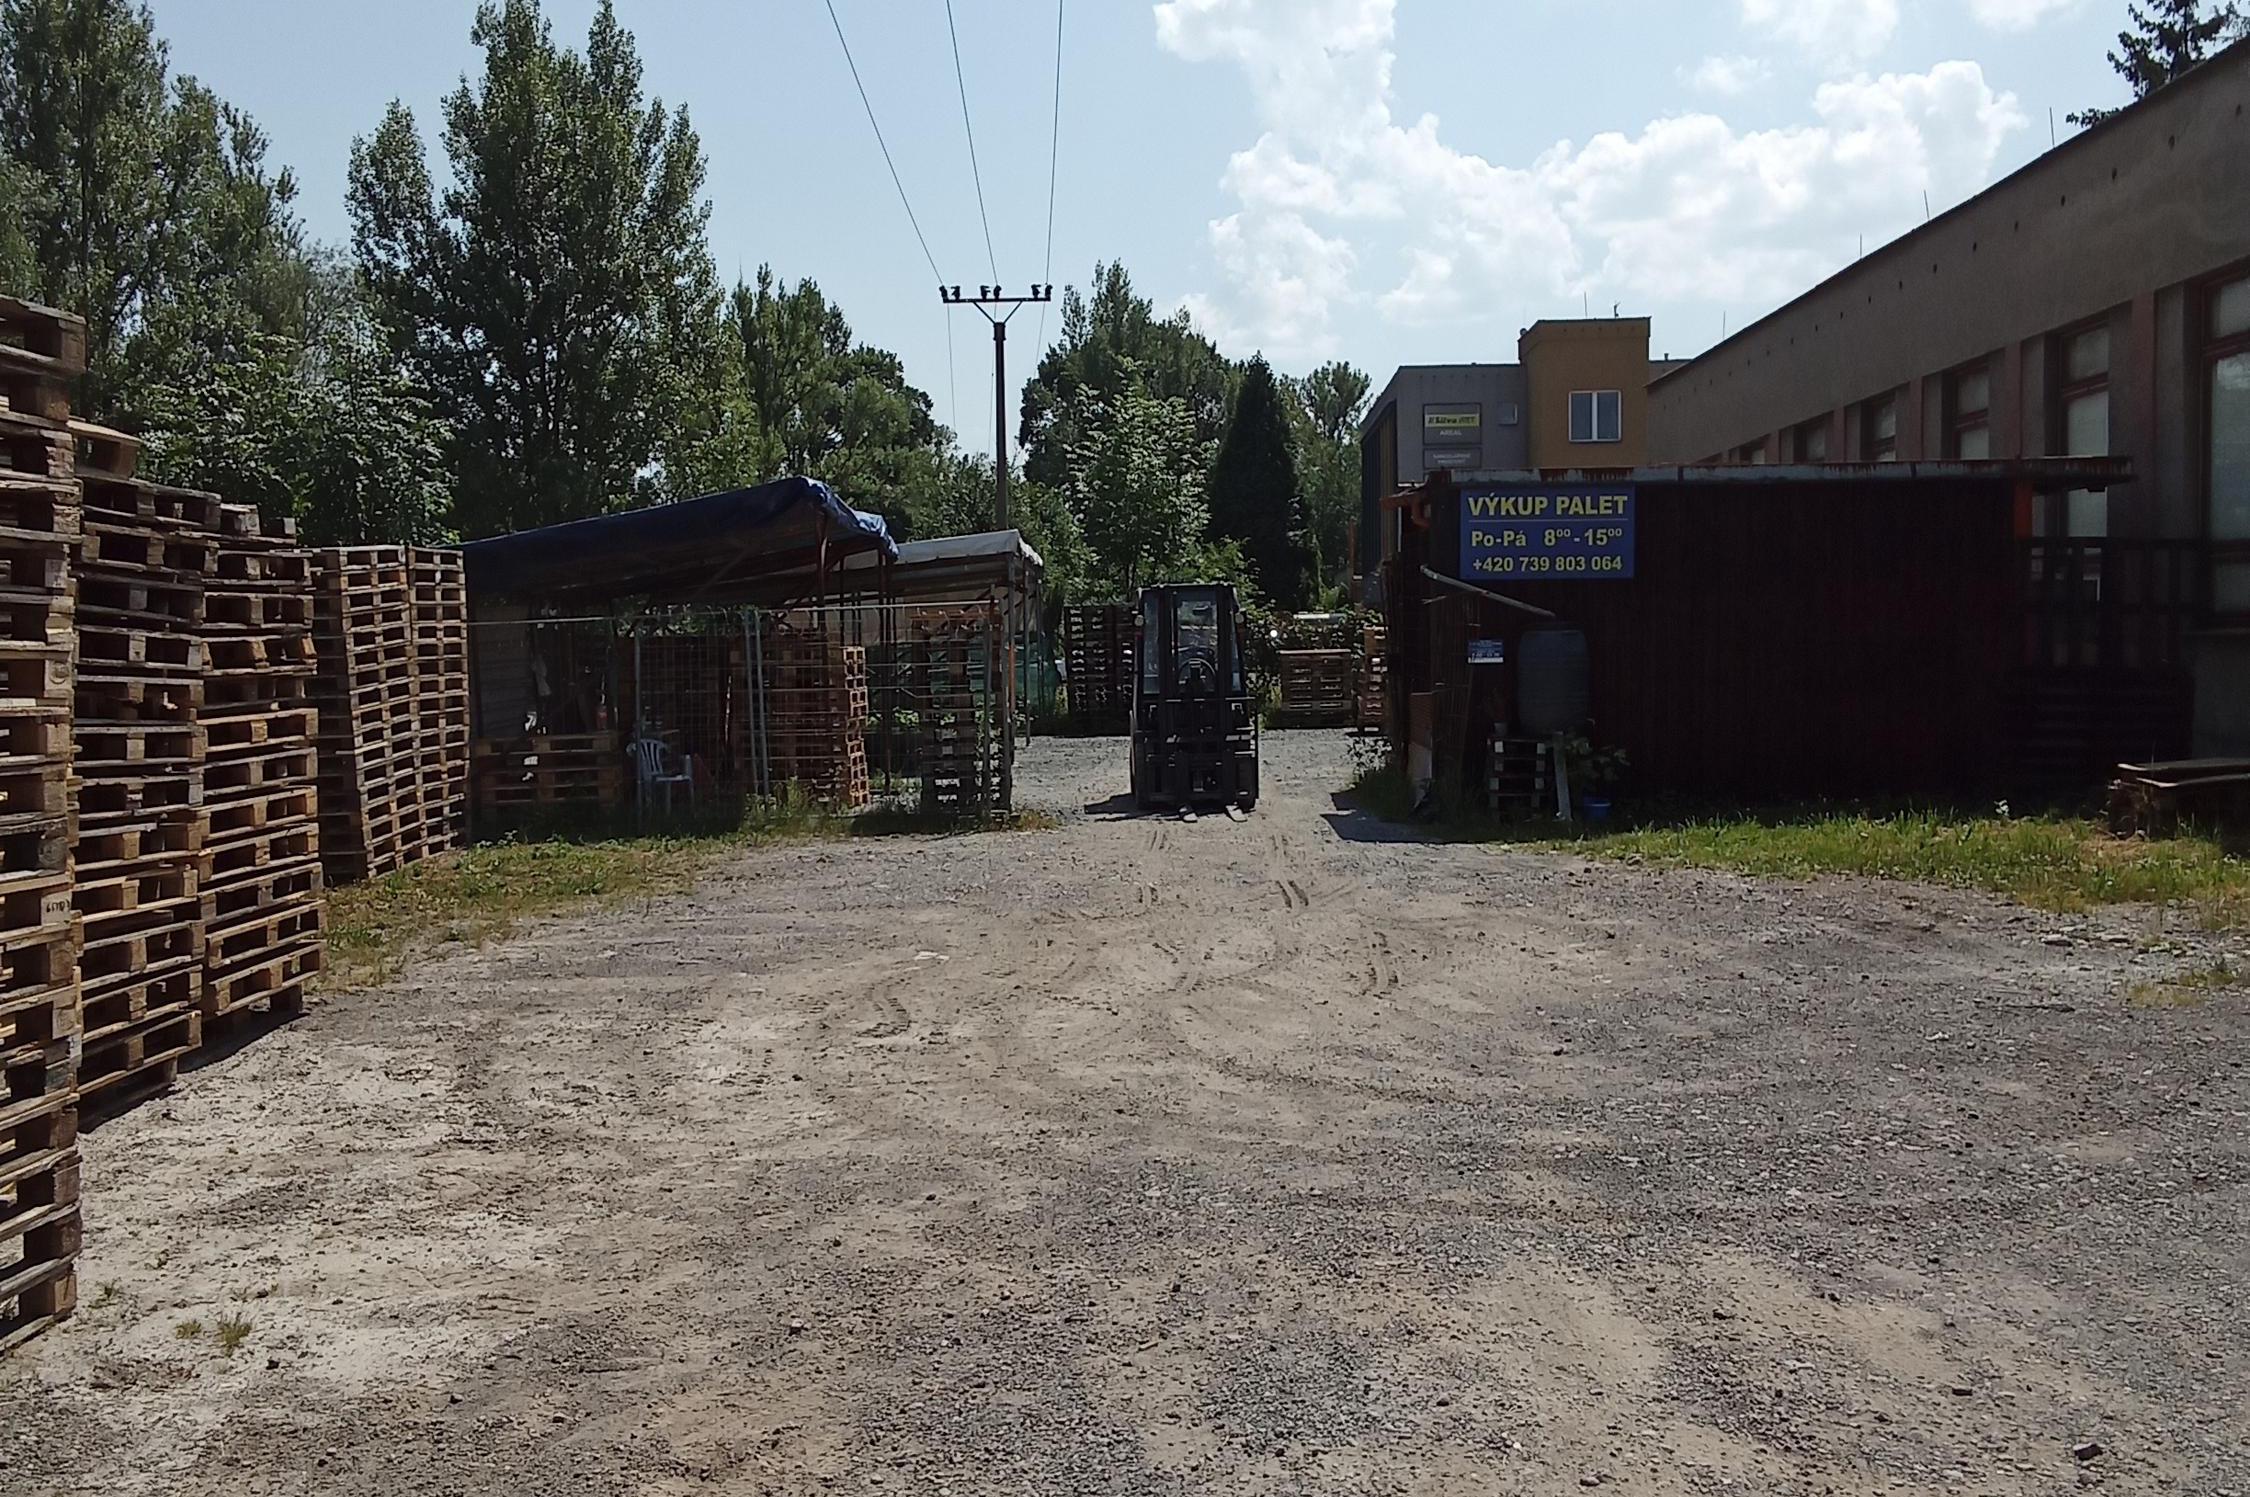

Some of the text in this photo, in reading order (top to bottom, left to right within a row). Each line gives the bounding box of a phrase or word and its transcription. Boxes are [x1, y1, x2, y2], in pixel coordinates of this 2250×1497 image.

[1468, 492, 1628, 516] VÝKUP PALET
[1471, 530, 1526, 547] Po-Pá
[1473, 556, 1622, 572] +420 739 803 064
